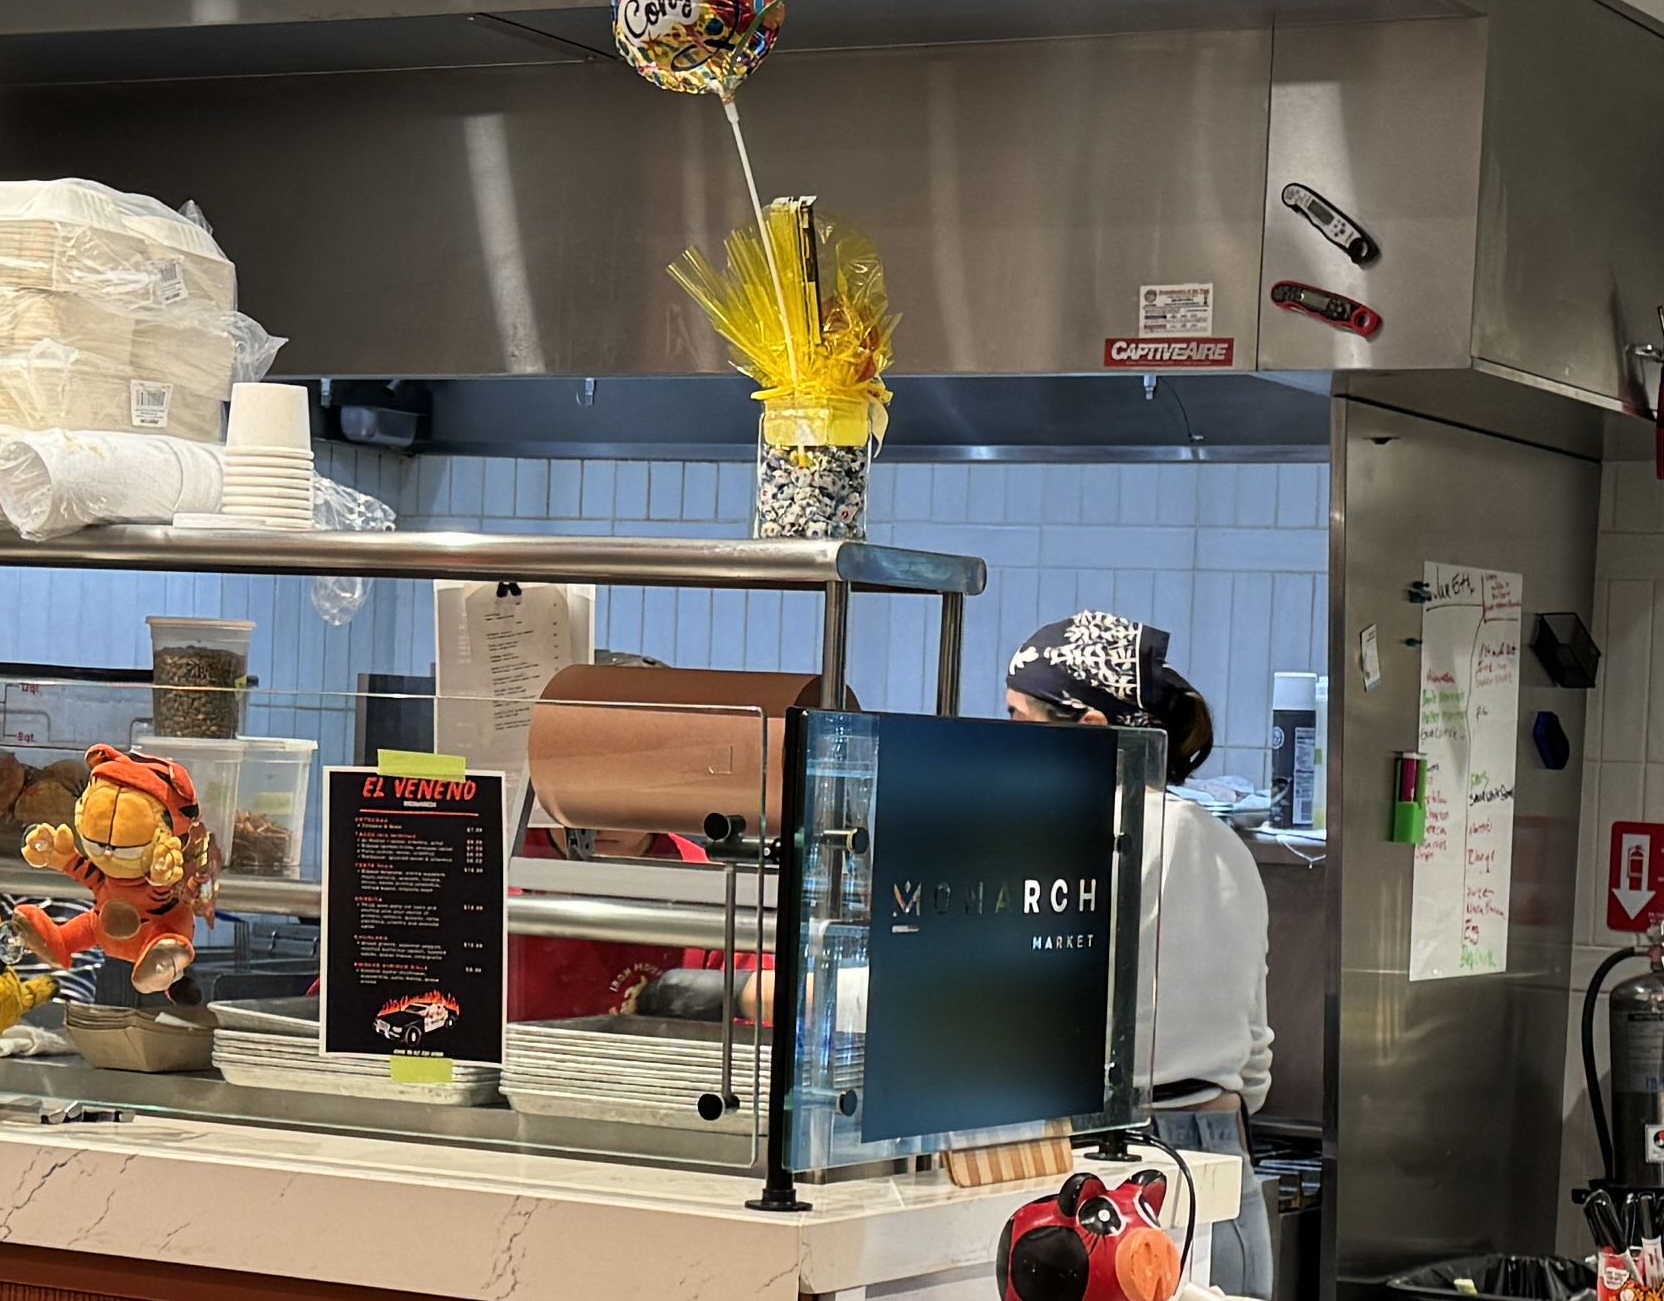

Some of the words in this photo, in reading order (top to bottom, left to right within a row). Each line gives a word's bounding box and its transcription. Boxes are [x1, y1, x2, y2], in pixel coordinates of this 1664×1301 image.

[362, 776, 385, 798] EL
[394, 778, 477, 801] VENENO
[1032, 934, 1094, 949] MARKET
